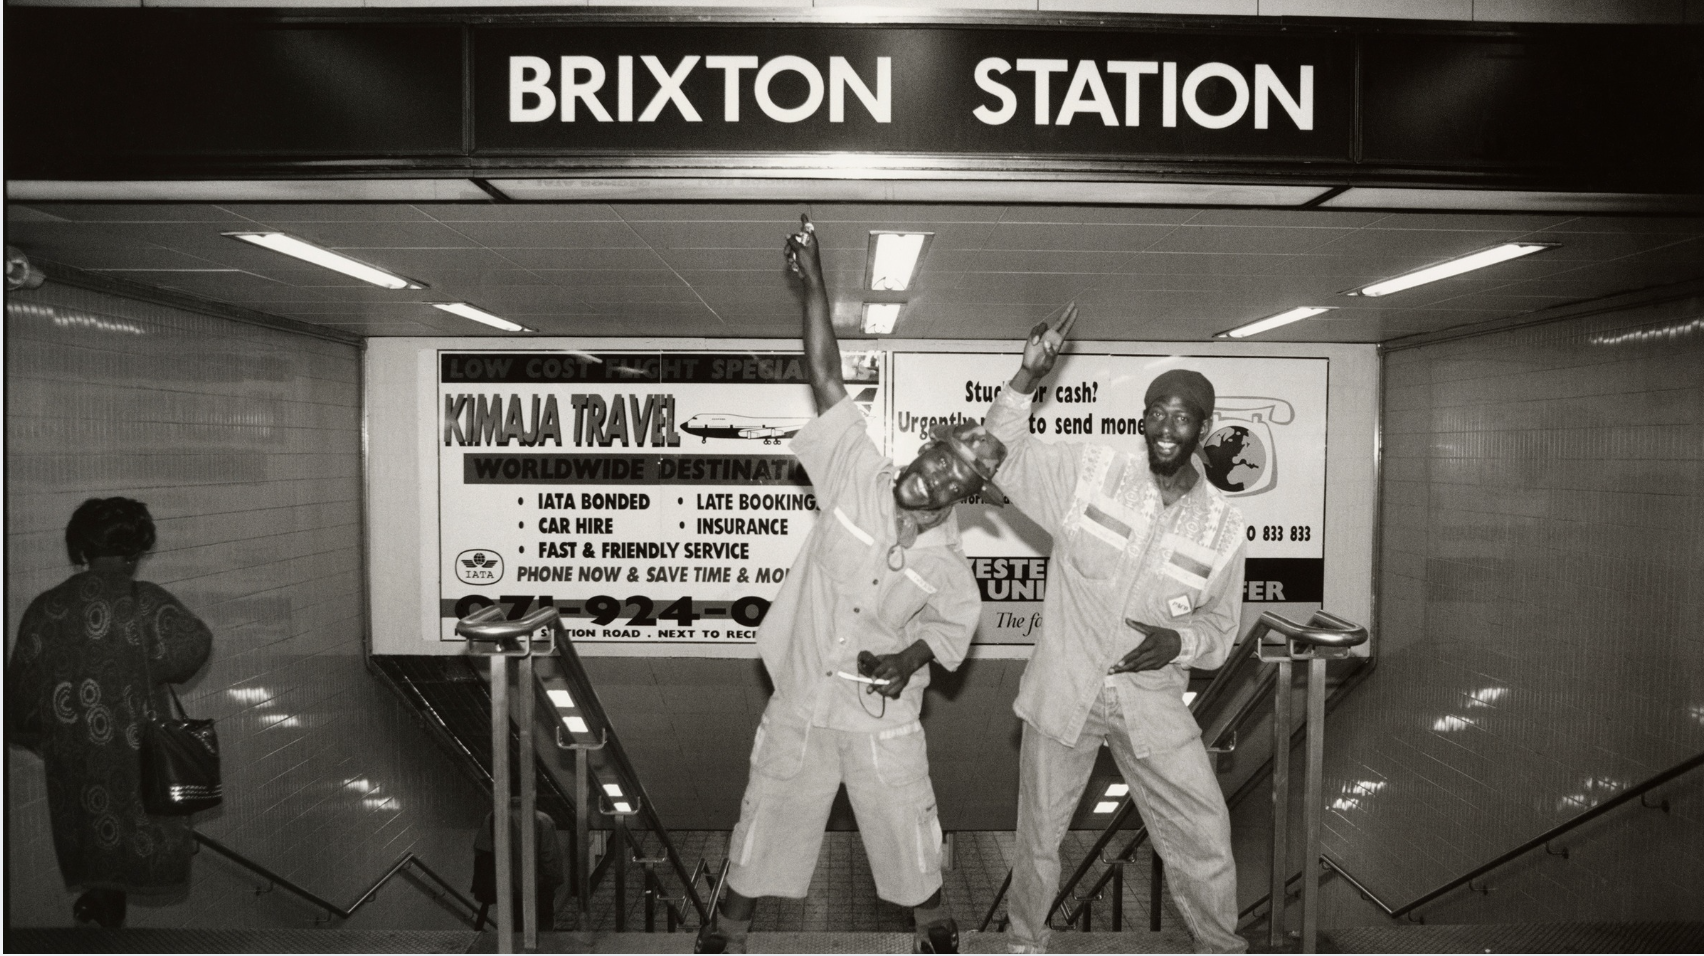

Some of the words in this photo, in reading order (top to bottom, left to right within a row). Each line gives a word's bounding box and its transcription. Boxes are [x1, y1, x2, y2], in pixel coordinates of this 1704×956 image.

[508, 54, 892, 124] BRIXTON
[972, 57, 1315, 131] STATION
[450, 358, 513, 379] LOW
[525, 358, 593, 379] COST
[605, 358, 700, 380] FLIGHT
[711, 358, 812, 380] SPECIA
[965, 380, 1005, 402] Stuc
[1055, 381, 1099, 403] cash?
[444, 393, 562, 447] KIMAJA
[571, 393, 681, 448] TRAVEL
[1028, 413, 1047, 434] to
[1055, 413, 1093, 435] send
[1101, 417, 1145, 435] mone
[473, 458, 645, 480] WORLDWIDE
[538, 493, 576, 510] IATA
[581, 493, 650, 510] BONDED
[697, 494, 733, 510] LATE
[538, 517, 571, 534] CAR
[576, 518, 613, 534] HIRE
[697, 518, 788, 535] INSURANCE
[1263, 525, 1283, 541] 833
[1290, 525, 1311, 541] 833
[539, 542, 577, 558] FAST
[582, 542, 595, 558] &
[602, 542, 680, 559] FRIENDLY
[684, 542, 749, 559] SERVICE
[465, 570, 494, 579] IATA
[517, 566, 573, 582] PHONE
[578, 566, 622, 582] NOW
[626, 567, 639, 582] &
[646, 566, 689, 582] SAVE
[694, 567, 731, 583] TIME
[736, 567, 749, 583] &
[755, 567, 791, 583] MO
[971, 558, 1046, 579] ESTE
[987, 579, 1046, 600] UNI
[996, 611, 1025, 629] The
[540, 629, 596, 637] SION
[602, 629, 641, 638] ROAD
[658, 629, 696, 638] NEXT
[702, 630, 720, 638] TO
[726, 630, 757, 639] REC
